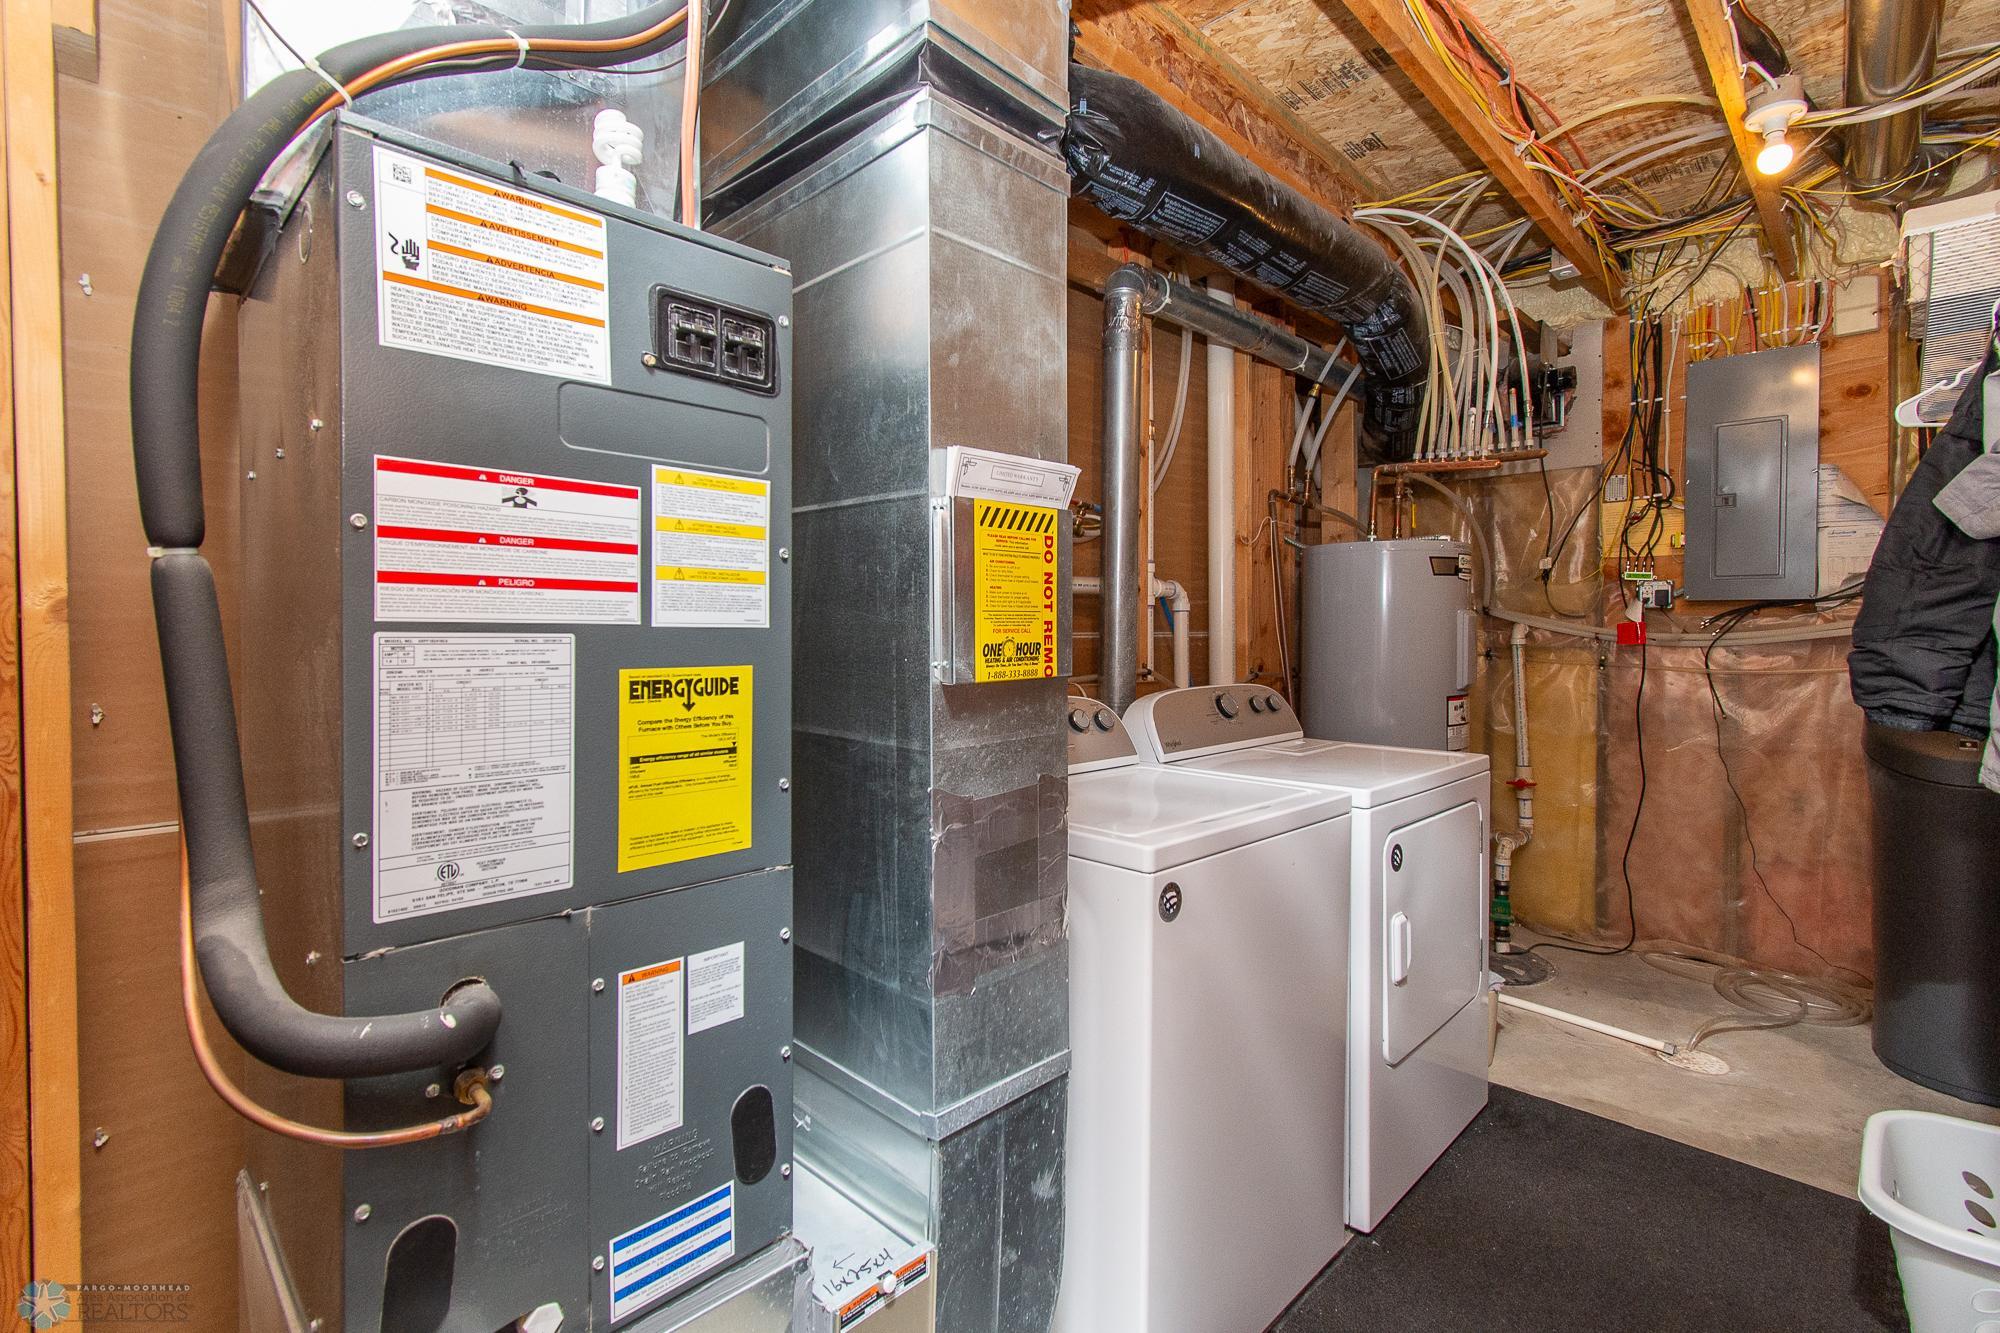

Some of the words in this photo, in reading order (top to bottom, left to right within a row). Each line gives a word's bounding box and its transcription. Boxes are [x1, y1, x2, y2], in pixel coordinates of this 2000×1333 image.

[500, 191, 542, 210] WARNING
[488, 222, 560, 247] AVERTISSEMENT
[494, 257, 555, 278] ADVERTENCIA
[484, 295, 527, 311] WARNING
[499, 475, 534, 486] DANGER
[996, 470, 1013, 479] LIMITED
[1013, 473, 1039, 483] WARRANTY
[499, 536, 534, 546] DANGER
[1044, 535, 1054, 564] DO
[498, 578, 535, 588] PELIGRO
[1043, 571, 1054, 612] NOT
[982, 642, 1002, 657] ONE
[1015, 640, 1041, 656] HOUR
[1043, 620, 1054, 678] REMO
[987, 667, 1038, 679] 1-888-333-8888
[629, 676, 739, 700] ENERGYGUIDE
[637, 719, 663, 727] Compare
[693, 714, 717, 722] Efficiency
[638, 725, 661, 733] Furnace
[638, 755, 655, 763] Energy
